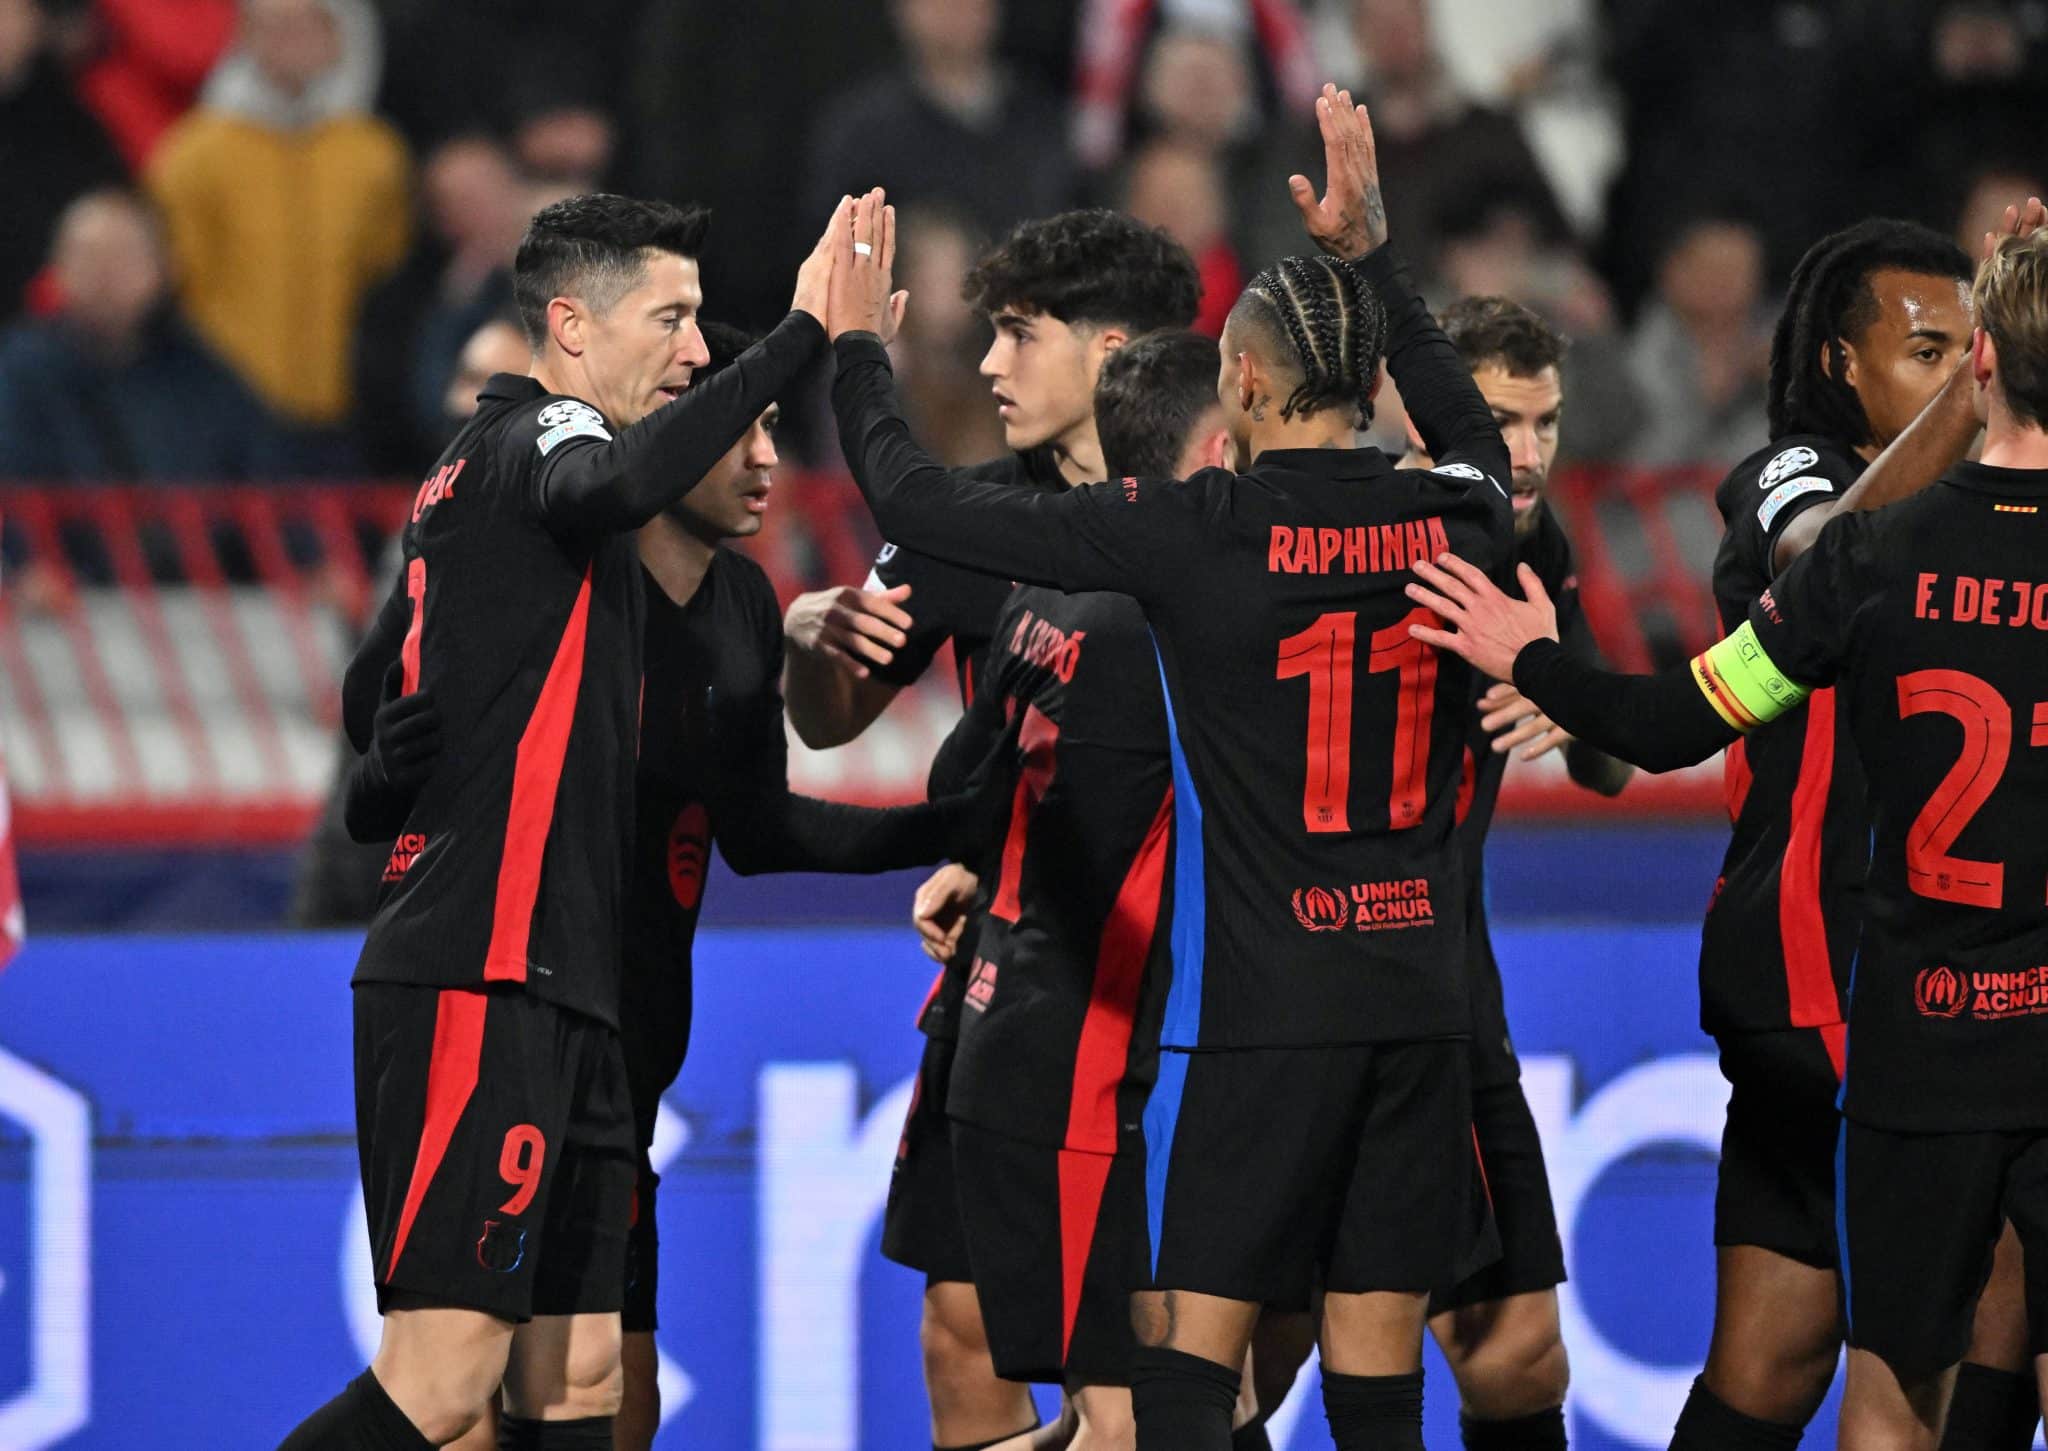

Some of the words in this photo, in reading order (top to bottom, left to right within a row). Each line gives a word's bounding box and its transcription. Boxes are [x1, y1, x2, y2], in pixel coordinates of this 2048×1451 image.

[1269, 516, 1449, 574] RAPHINHA
[1915, 573, 1941, 620] F.
[1953, 576, 2005, 625] DE
[1276, 607, 1444, 834] 11
[1896, 669, 2048, 909] 2
[1350, 878, 1429, 904] UNHCR
[1355, 898, 1433, 924] ACNUR
[499, 1124, 546, 1216] 9
